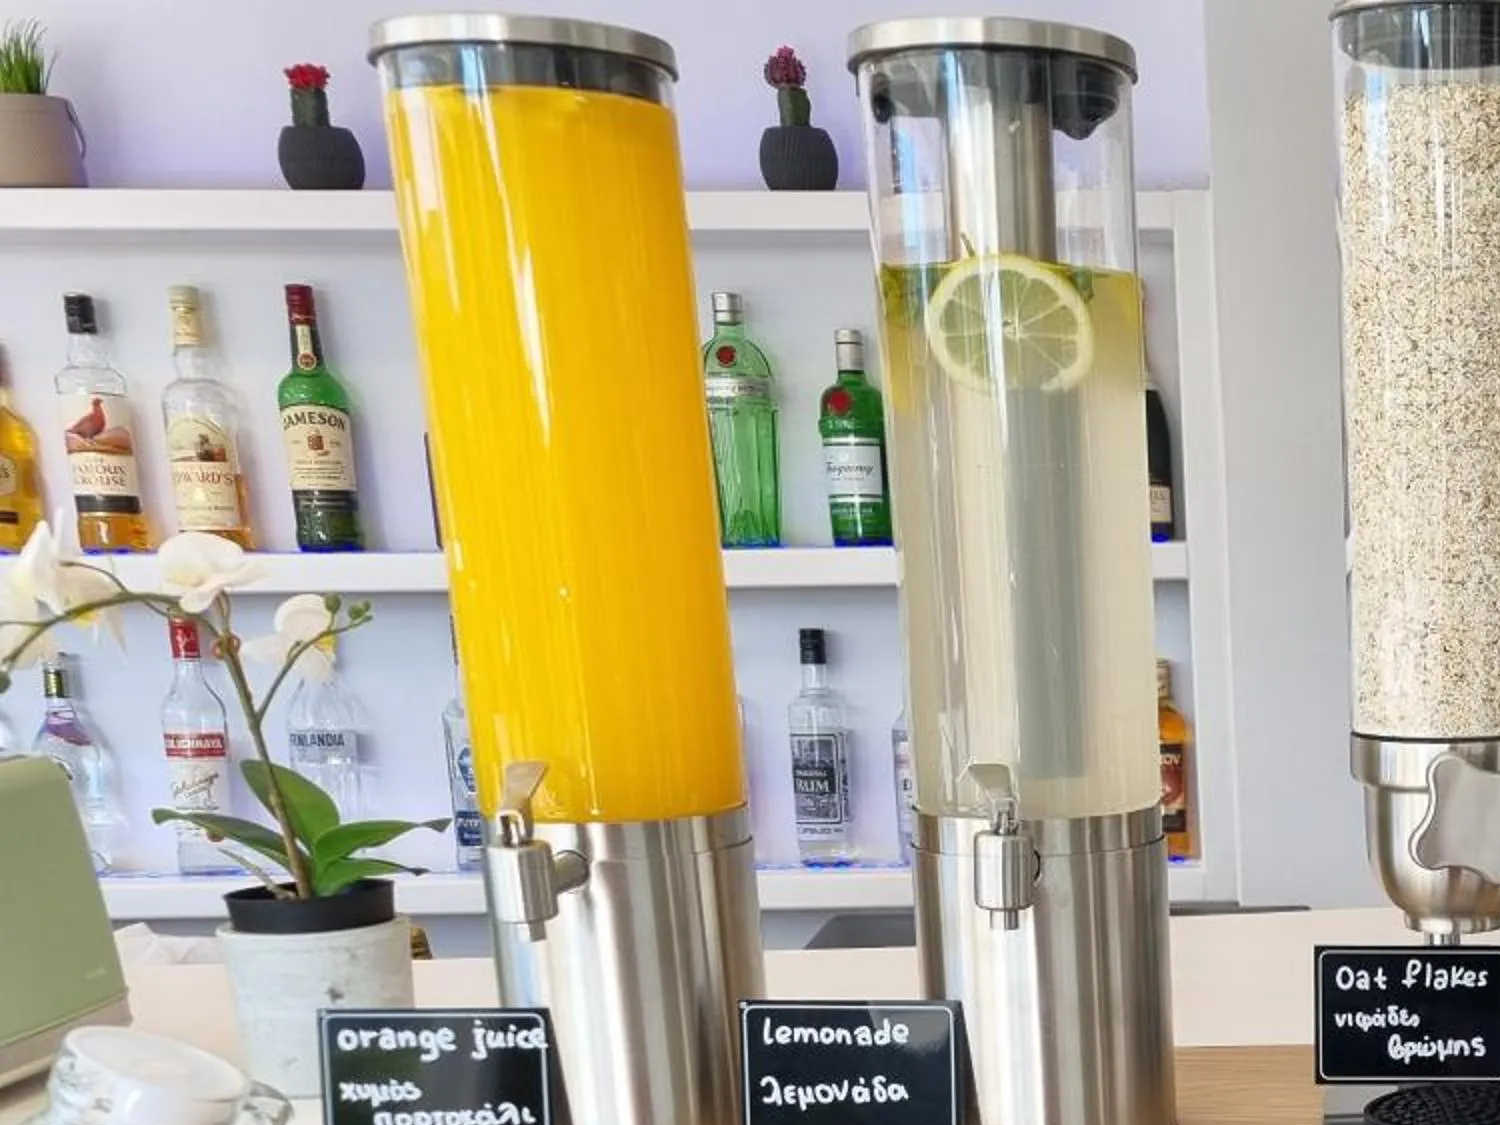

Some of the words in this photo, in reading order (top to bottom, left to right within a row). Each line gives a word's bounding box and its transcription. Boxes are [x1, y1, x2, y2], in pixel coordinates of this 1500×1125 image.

[283, 411, 345, 432] JAMESON
[1335, 965, 1388, 991] Oat
[1401, 958, 1489, 991] flakes
[337, 1027, 458, 1062] orange
[470, 1019, 548, 1060] juice
[760, 1075, 909, 1112] λεμονάδα
